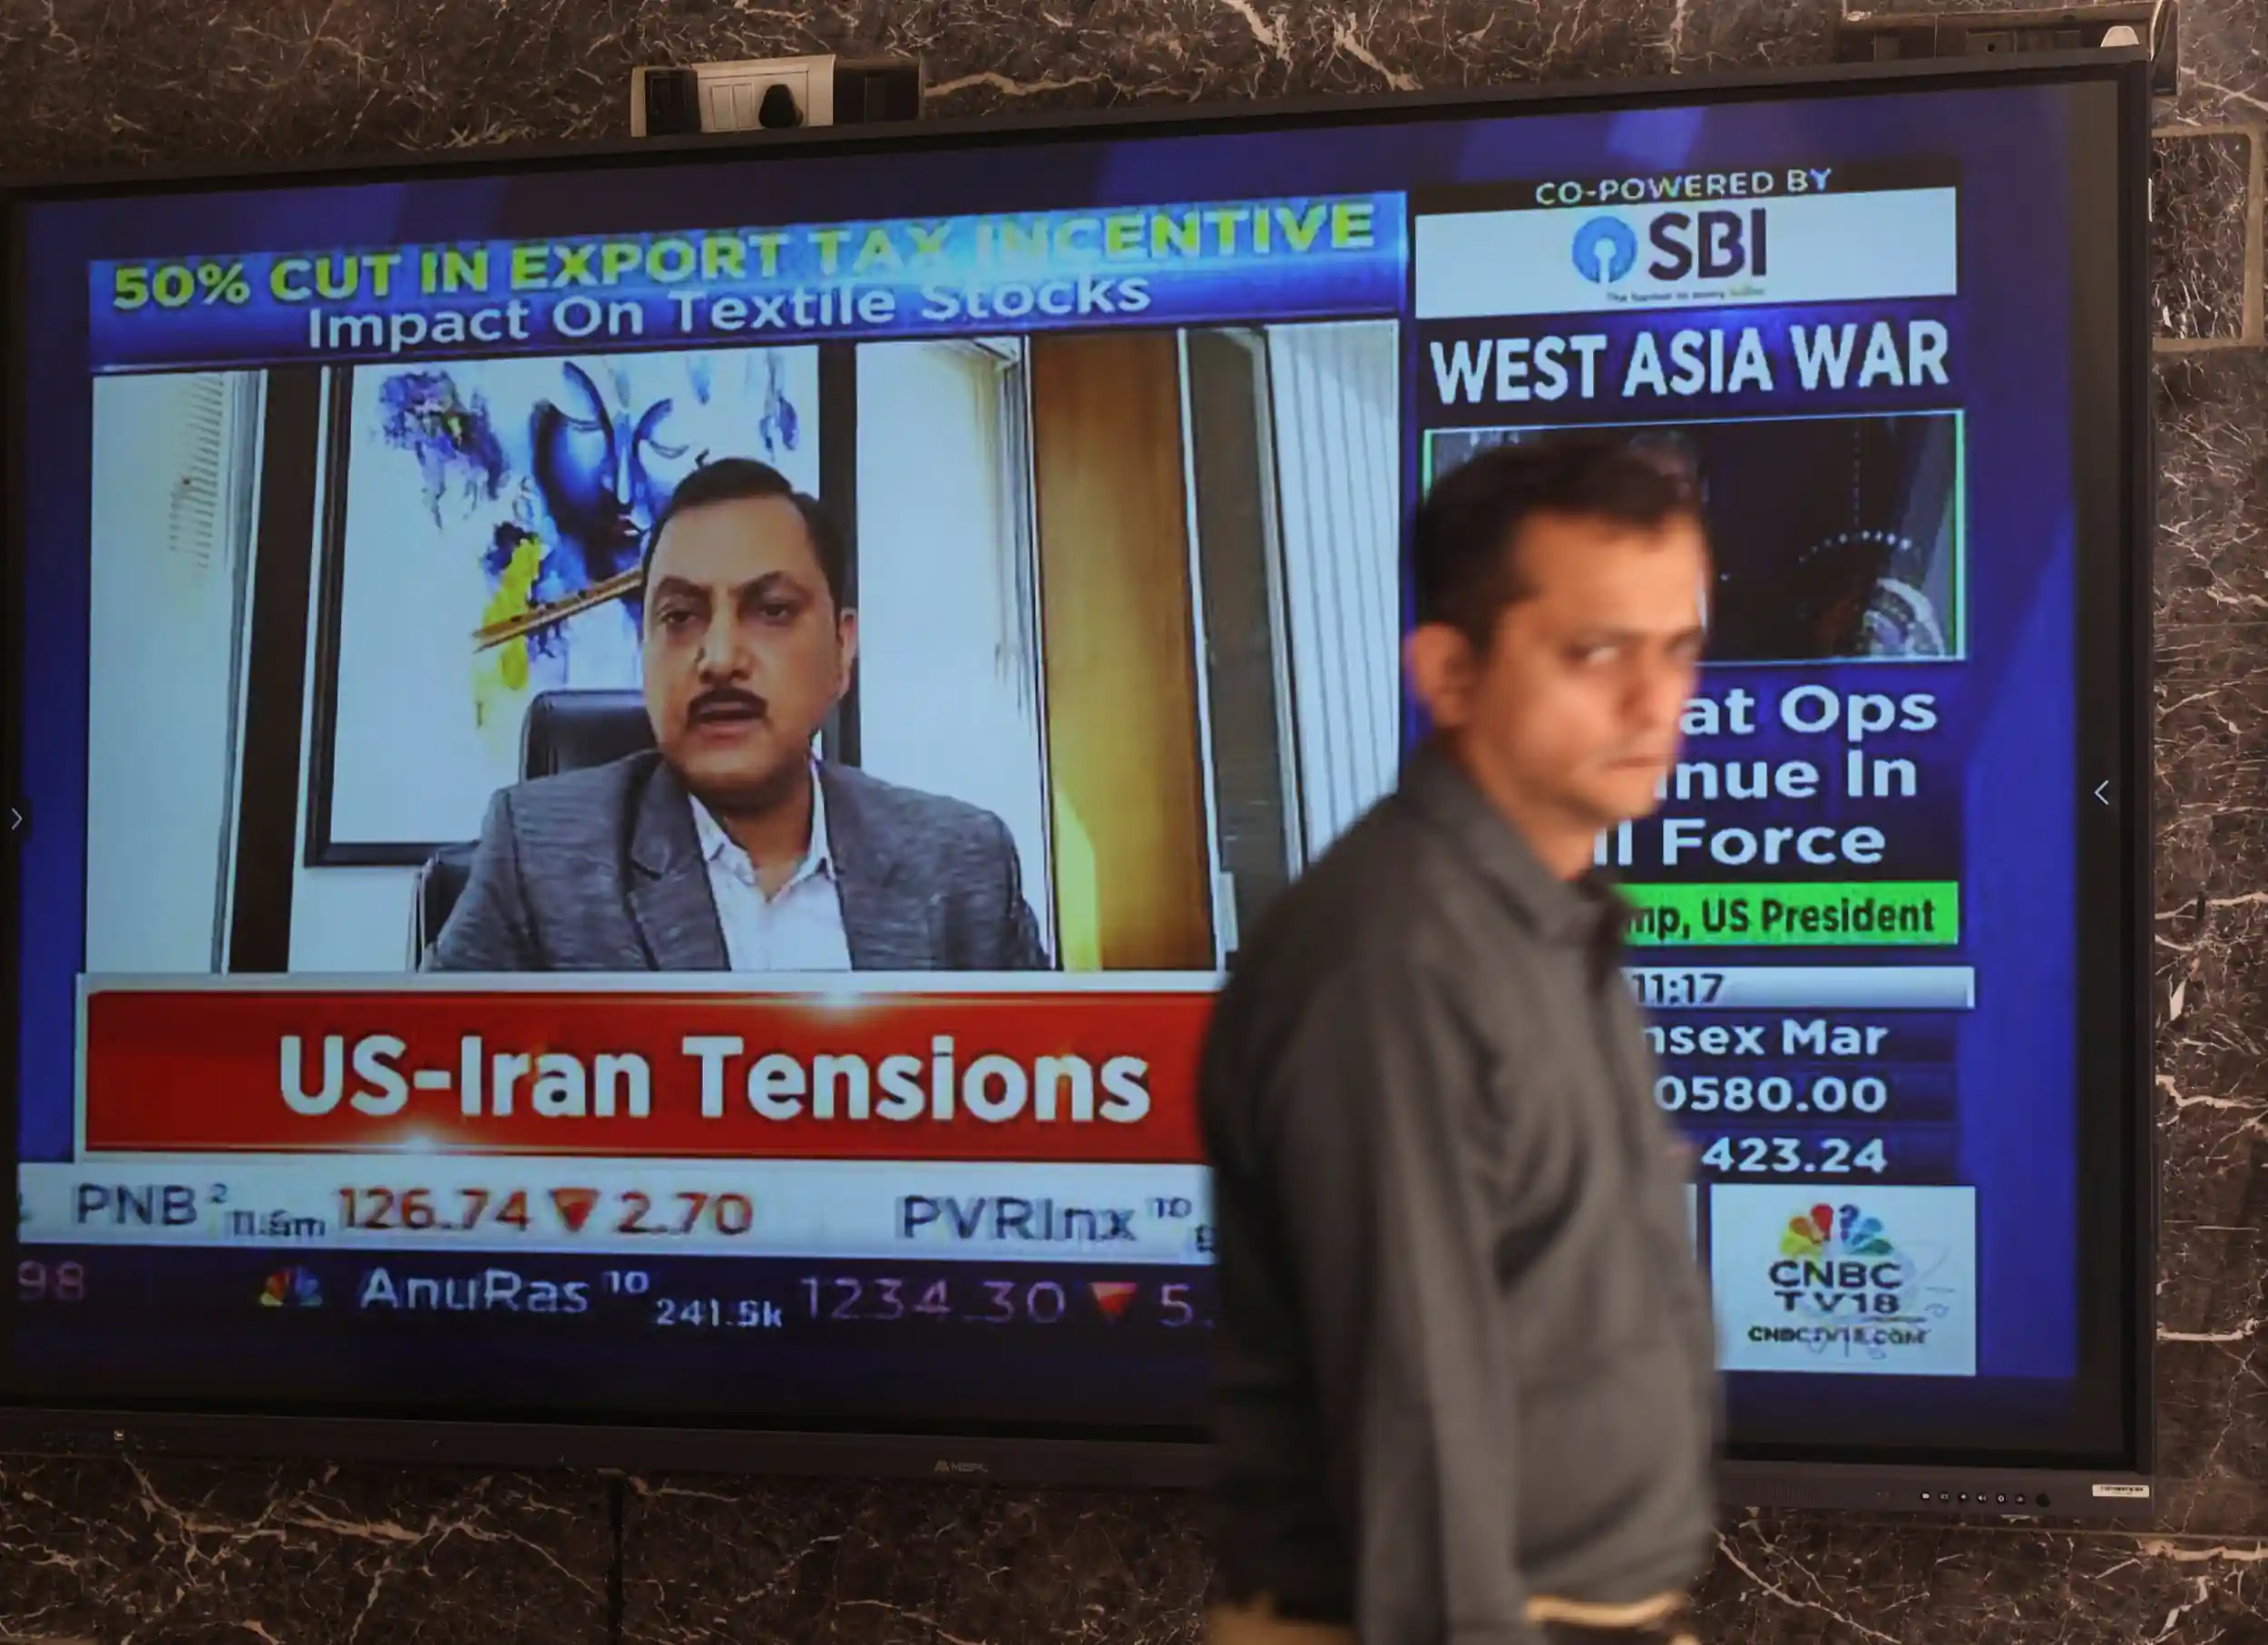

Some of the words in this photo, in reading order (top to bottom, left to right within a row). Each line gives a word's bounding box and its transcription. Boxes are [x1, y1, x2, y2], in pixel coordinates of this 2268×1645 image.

[1535, 171, 1774, 205] CO-POWERED
[1786, 167, 1833, 192] BY
[113, 261, 250, 308] 50%
[269, 254, 401, 302] CUT
[421, 250, 488, 296] IN
[511, 232, 789, 291] EXPORT
[808, 221, 951, 276] TAX
[977, 202, 1374, 263] INCENTIVE
[1648, 208, 1767, 280] SBI
[308, 301, 530, 353] Impact
[552, 295, 644, 338] On
[668, 285, 896, 333] Textile
[921, 271, 1152, 321] Stocks
[1430, 335, 1608, 405] WEST
[1622, 328, 1774, 397] ASIA
[1789, 320, 1950, 390] WAR
[1780, 684, 1938, 742] Ops
[1847, 749, 1917, 798] In
[1662, 818, 1886, 866] Force
[1702, 897, 1749, 932] US
[1761, 896, 1936, 934] President
[1783, 1019, 1889, 1056] Mar
[279, 1035, 650, 1119] US-Iran
[681, 1035, 1150, 1123] Tensions
[76, 1183, 199, 1226] PNB
[337, 1186, 530, 1231] 126.74
[619, 1191, 755, 1237] 2.70
[902, 1194, 1139, 1242] PVRInx
[359, 1266, 591, 1315] AnuRas
[607, 1270, 650, 1295] 10
[1768, 1259, 1903, 1290] CNBC
[1774, 1290, 1901, 1315] TV18
